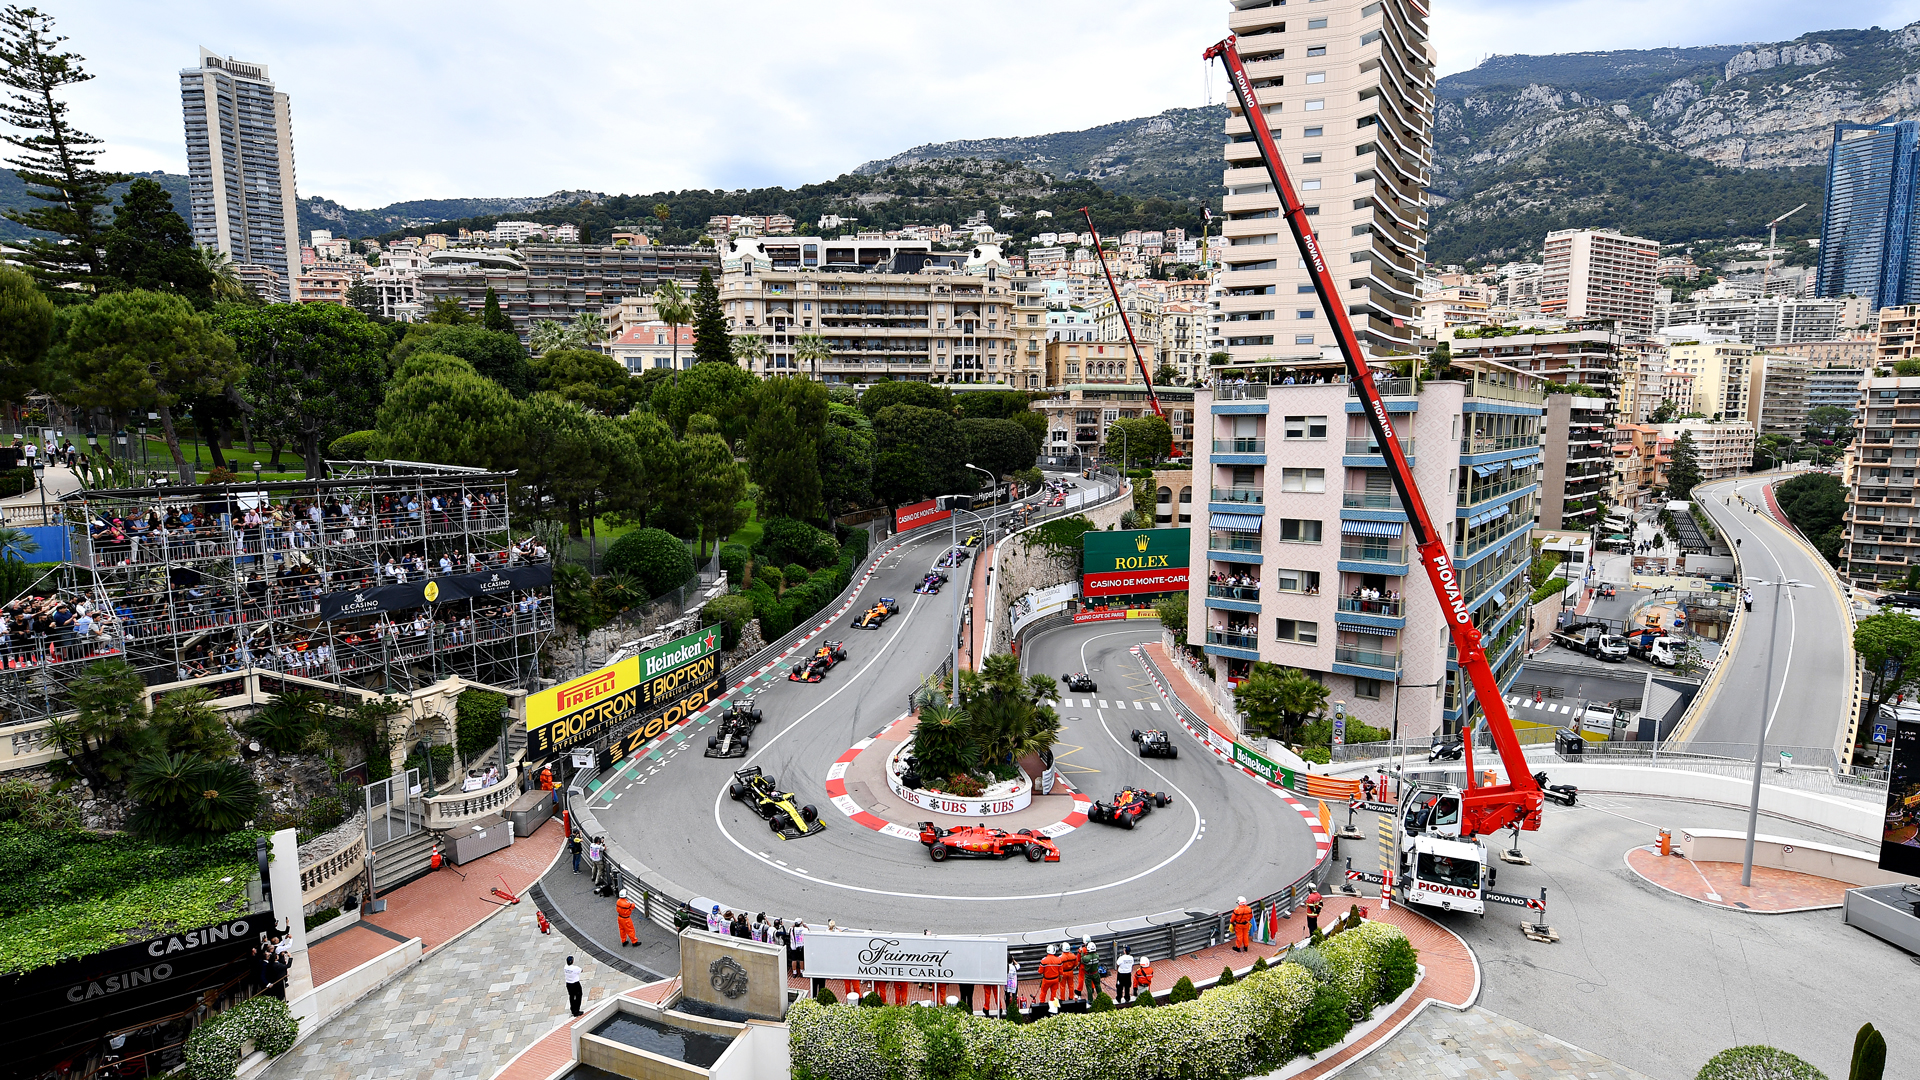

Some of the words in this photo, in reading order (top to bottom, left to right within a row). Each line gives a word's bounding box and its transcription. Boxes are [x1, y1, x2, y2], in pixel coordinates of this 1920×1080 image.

[1235, 69, 1255, 109] PIOVANO
[1303, 234, 1324, 273] PIOVANO
[1372, 400, 1392, 438] PIOVANO
[898, 511, 914, 524] CASINO
[914, 510, 920, 519] DE
[1115, 555, 1168, 569] ROLEX
[487, 579, 511, 588] CASINO
[1090, 579, 1121, 588] CASINO
[1123, 578, 1135, 586] DE
[1136, 575, 1190, 585] MONTE-CARL
[1433, 555, 1469, 625] PIOVANO
[350, 600, 379, 610] CASINO
[645, 637, 702, 677] Heineken
[557, 670, 616, 712] PIRELLI
[653, 654, 714, 697] BIOPTRON
[653, 684, 690, 705] HYPERLIGHT
[692, 670, 714, 687] THERAPY
[551, 689, 637, 744] BIOPTRON
[552, 725, 601, 753] HYPERLIGHT
[605, 709, 636, 728] THERAPY
[627, 680, 718, 752] zepter
[1237, 748, 1272, 778] Heineken
[902, 789, 920, 805] UBS
[941, 801, 967, 813] UBS
[992, 800, 1014, 814] UBS
[1418, 881, 1477, 899] PIOVANO
[1486, 893, 1525, 905] PIOVANO
[148, 920, 250, 958] CASINO
[857, 938, 952, 967] Fairmont
[66, 963, 173, 1003] CASINO
[857, 966, 904, 976] MONTE
[909, 967, 954, 978] CARLO
